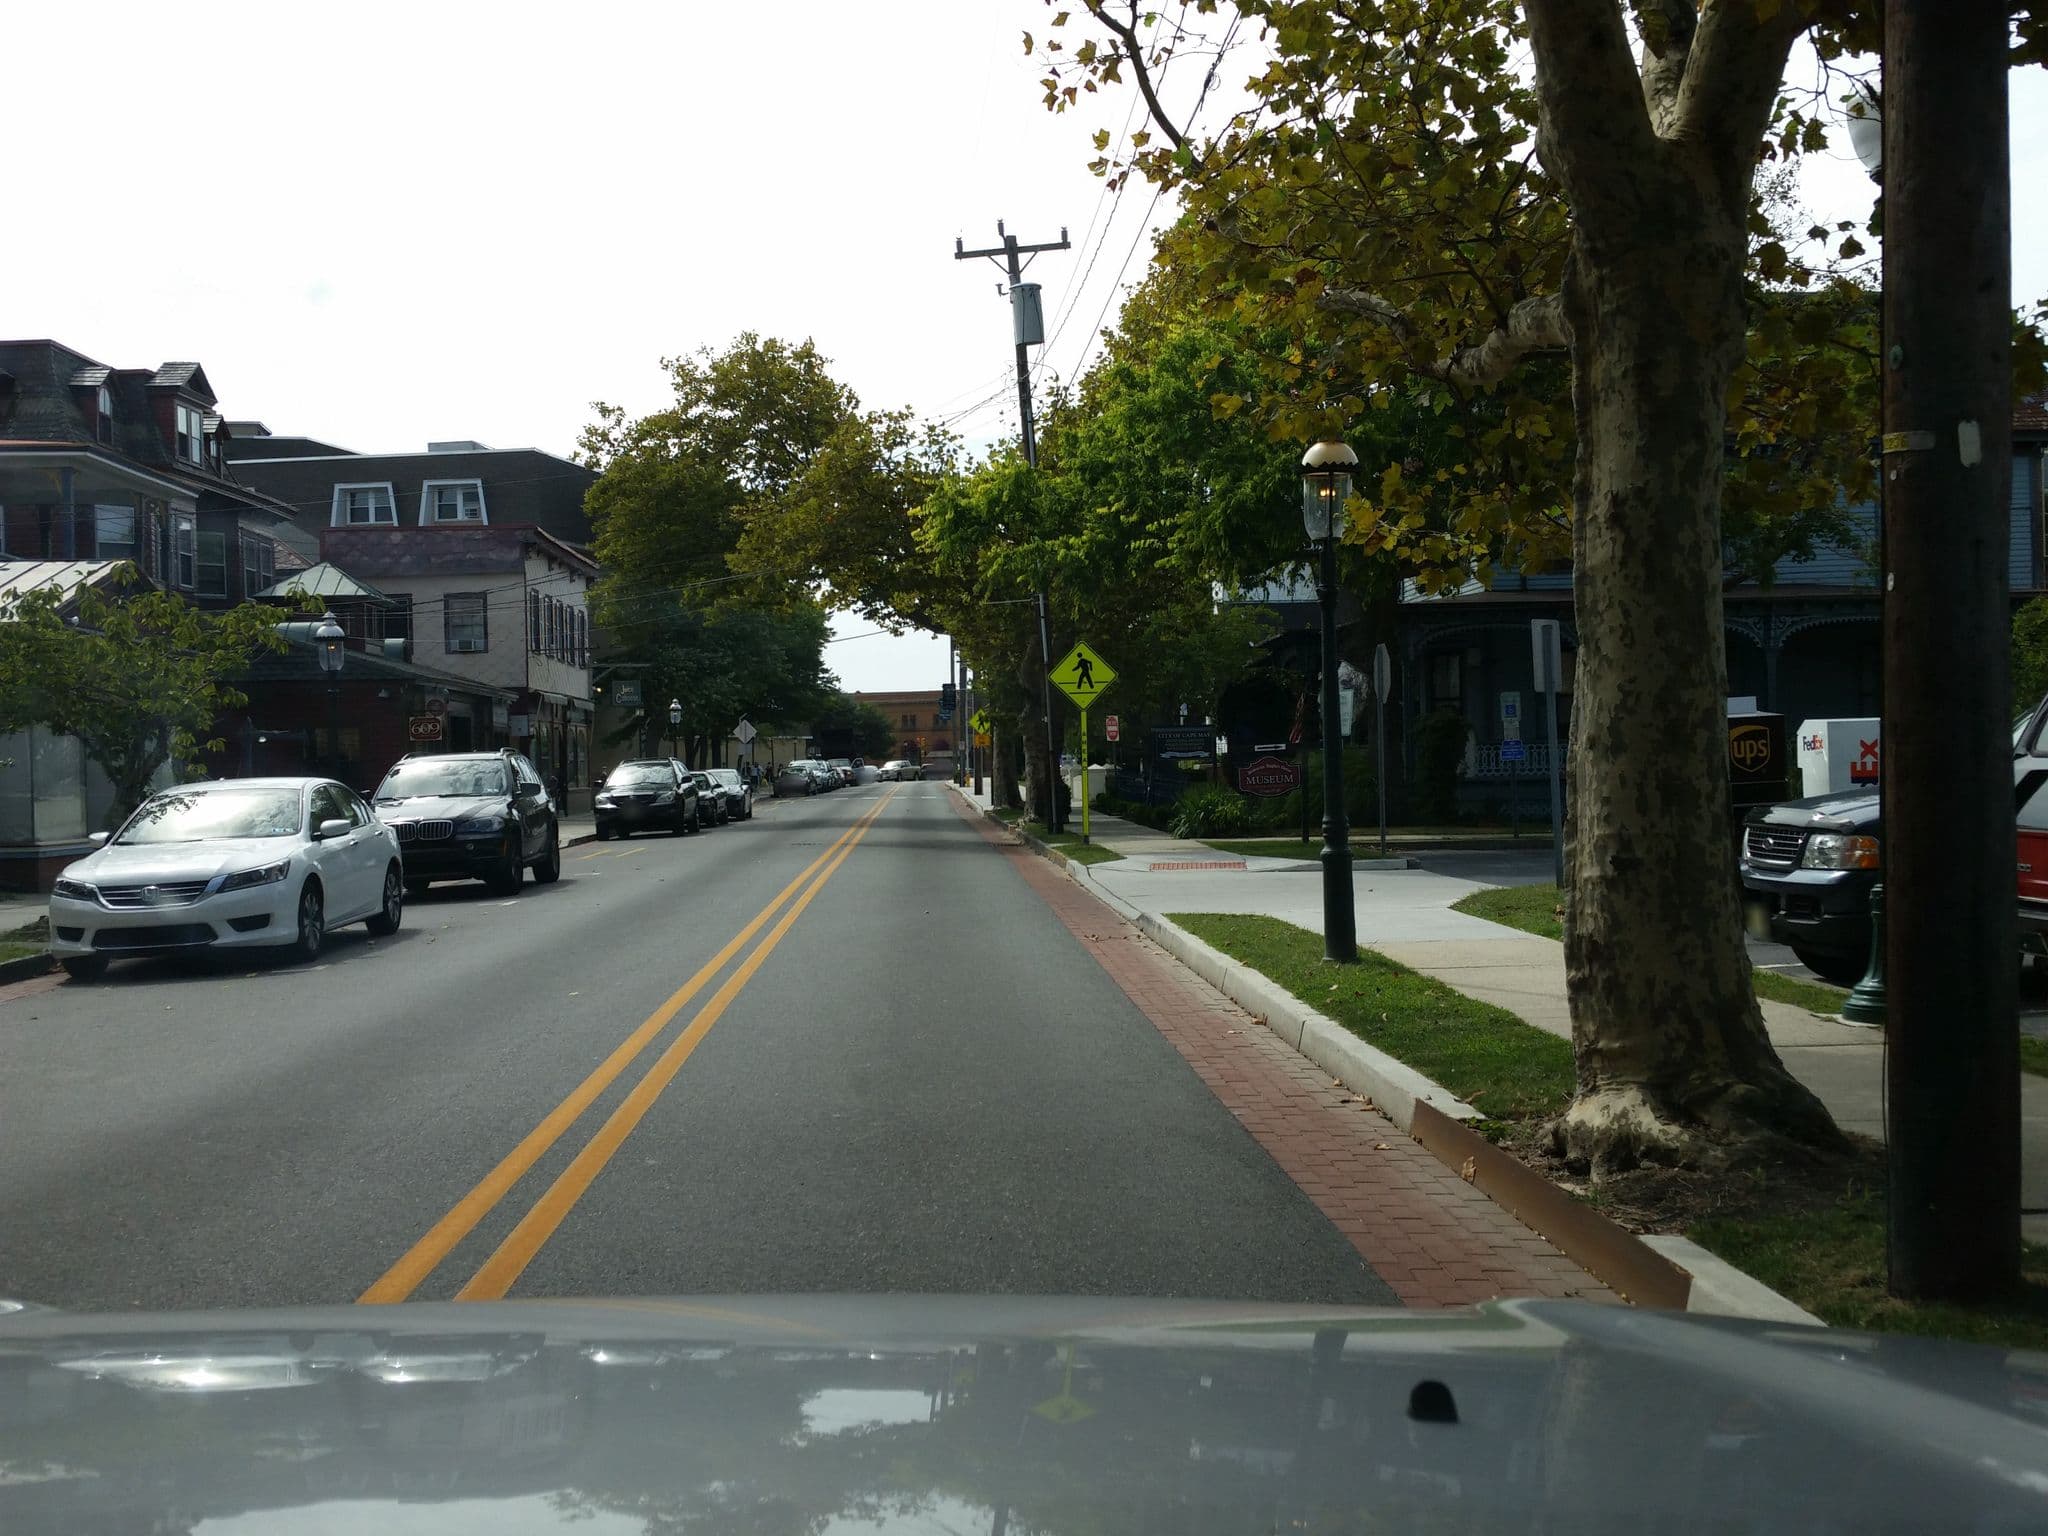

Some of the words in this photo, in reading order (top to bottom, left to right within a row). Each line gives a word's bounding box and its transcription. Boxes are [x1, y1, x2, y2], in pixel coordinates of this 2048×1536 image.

[412, 722, 440, 735] 609
[1803, 735, 1824, 751] FedEx
[1734, 740, 1768, 765] ups
[1246, 774, 1294, 785] MUSEUM
